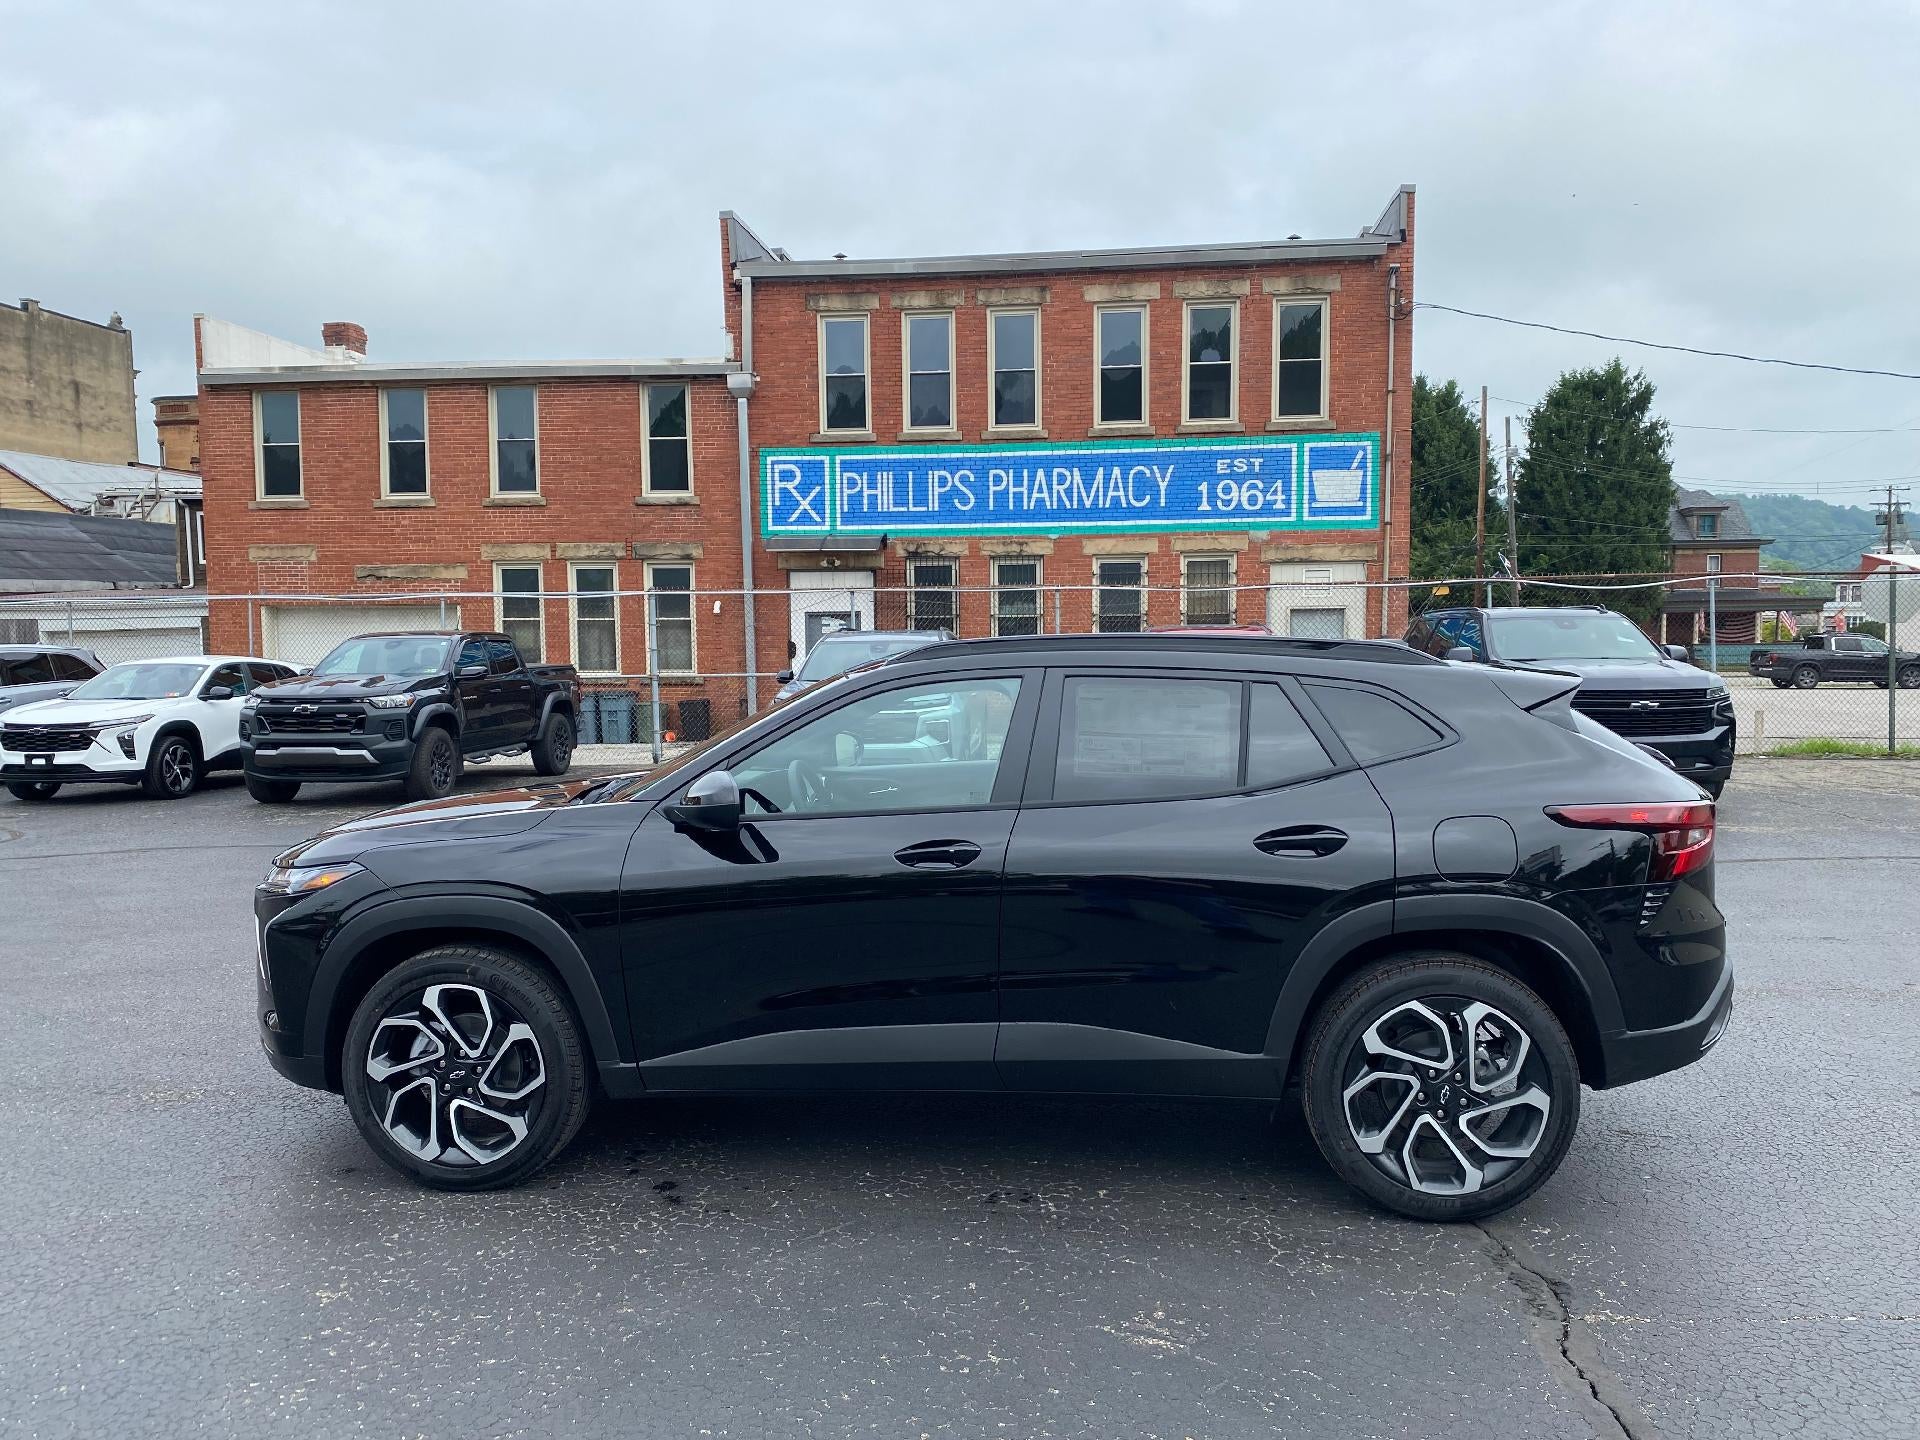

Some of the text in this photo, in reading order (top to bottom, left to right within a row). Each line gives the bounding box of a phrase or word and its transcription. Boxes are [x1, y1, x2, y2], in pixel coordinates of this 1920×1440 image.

[1216, 457, 1264, 474] EST
[842, 464, 1175, 513] PHILLIPS PHARMACY
[1197, 479, 1286, 511] 1964
